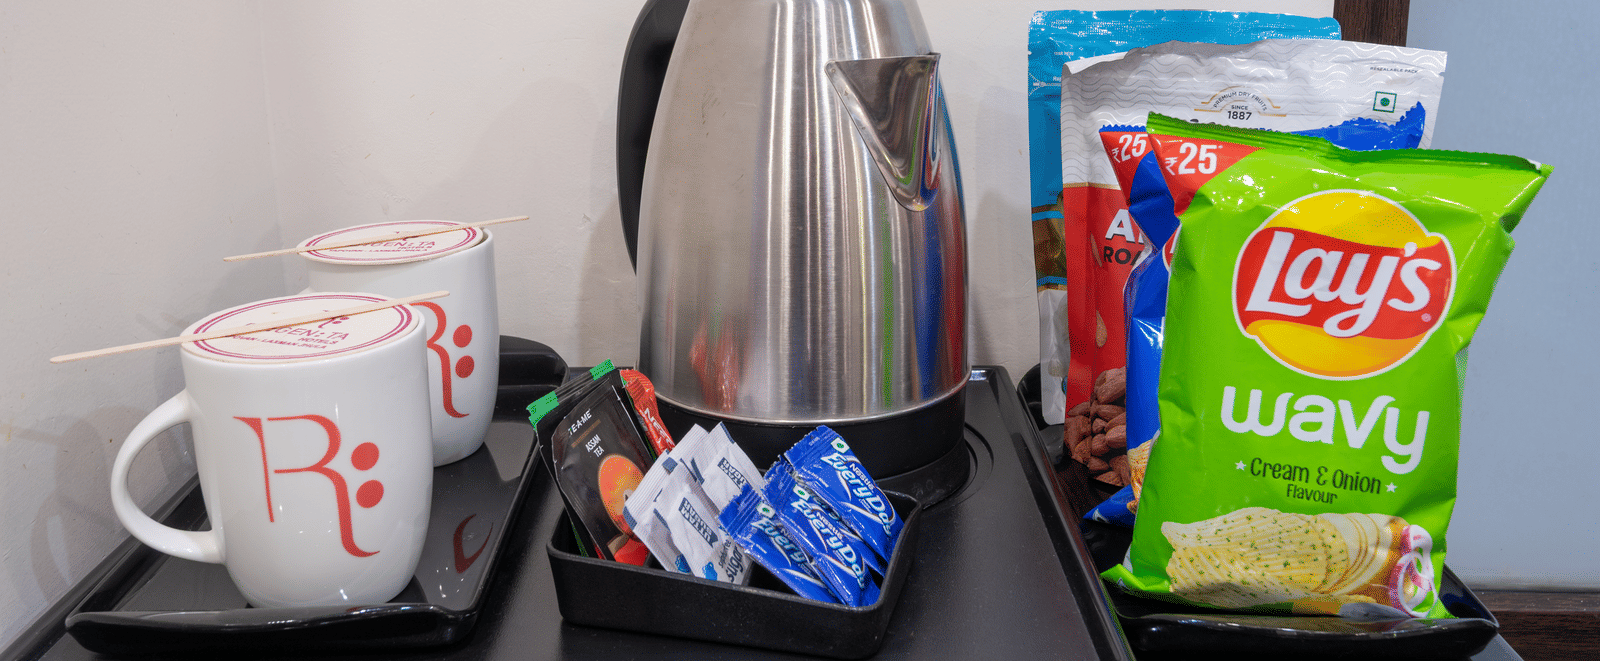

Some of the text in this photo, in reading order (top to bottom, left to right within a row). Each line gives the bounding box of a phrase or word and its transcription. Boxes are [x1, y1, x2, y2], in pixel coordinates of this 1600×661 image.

[1213, 91, 1237, 108] PREMIUM
[1251, 93, 1268, 111] FRUITS
[1227, 110, 1252, 121] 1887
[1245, 230, 1442, 338] Lay's
[1220, 386, 1430, 475] wavy
[585, 434, 602, 453] ASSAM
[593, 445, 605, 458] TEA
[1250, 457, 1381, 494] Cream & Onion
[1286, 483, 1338, 505] Flavour
[725, 545, 744, 583] sugar
